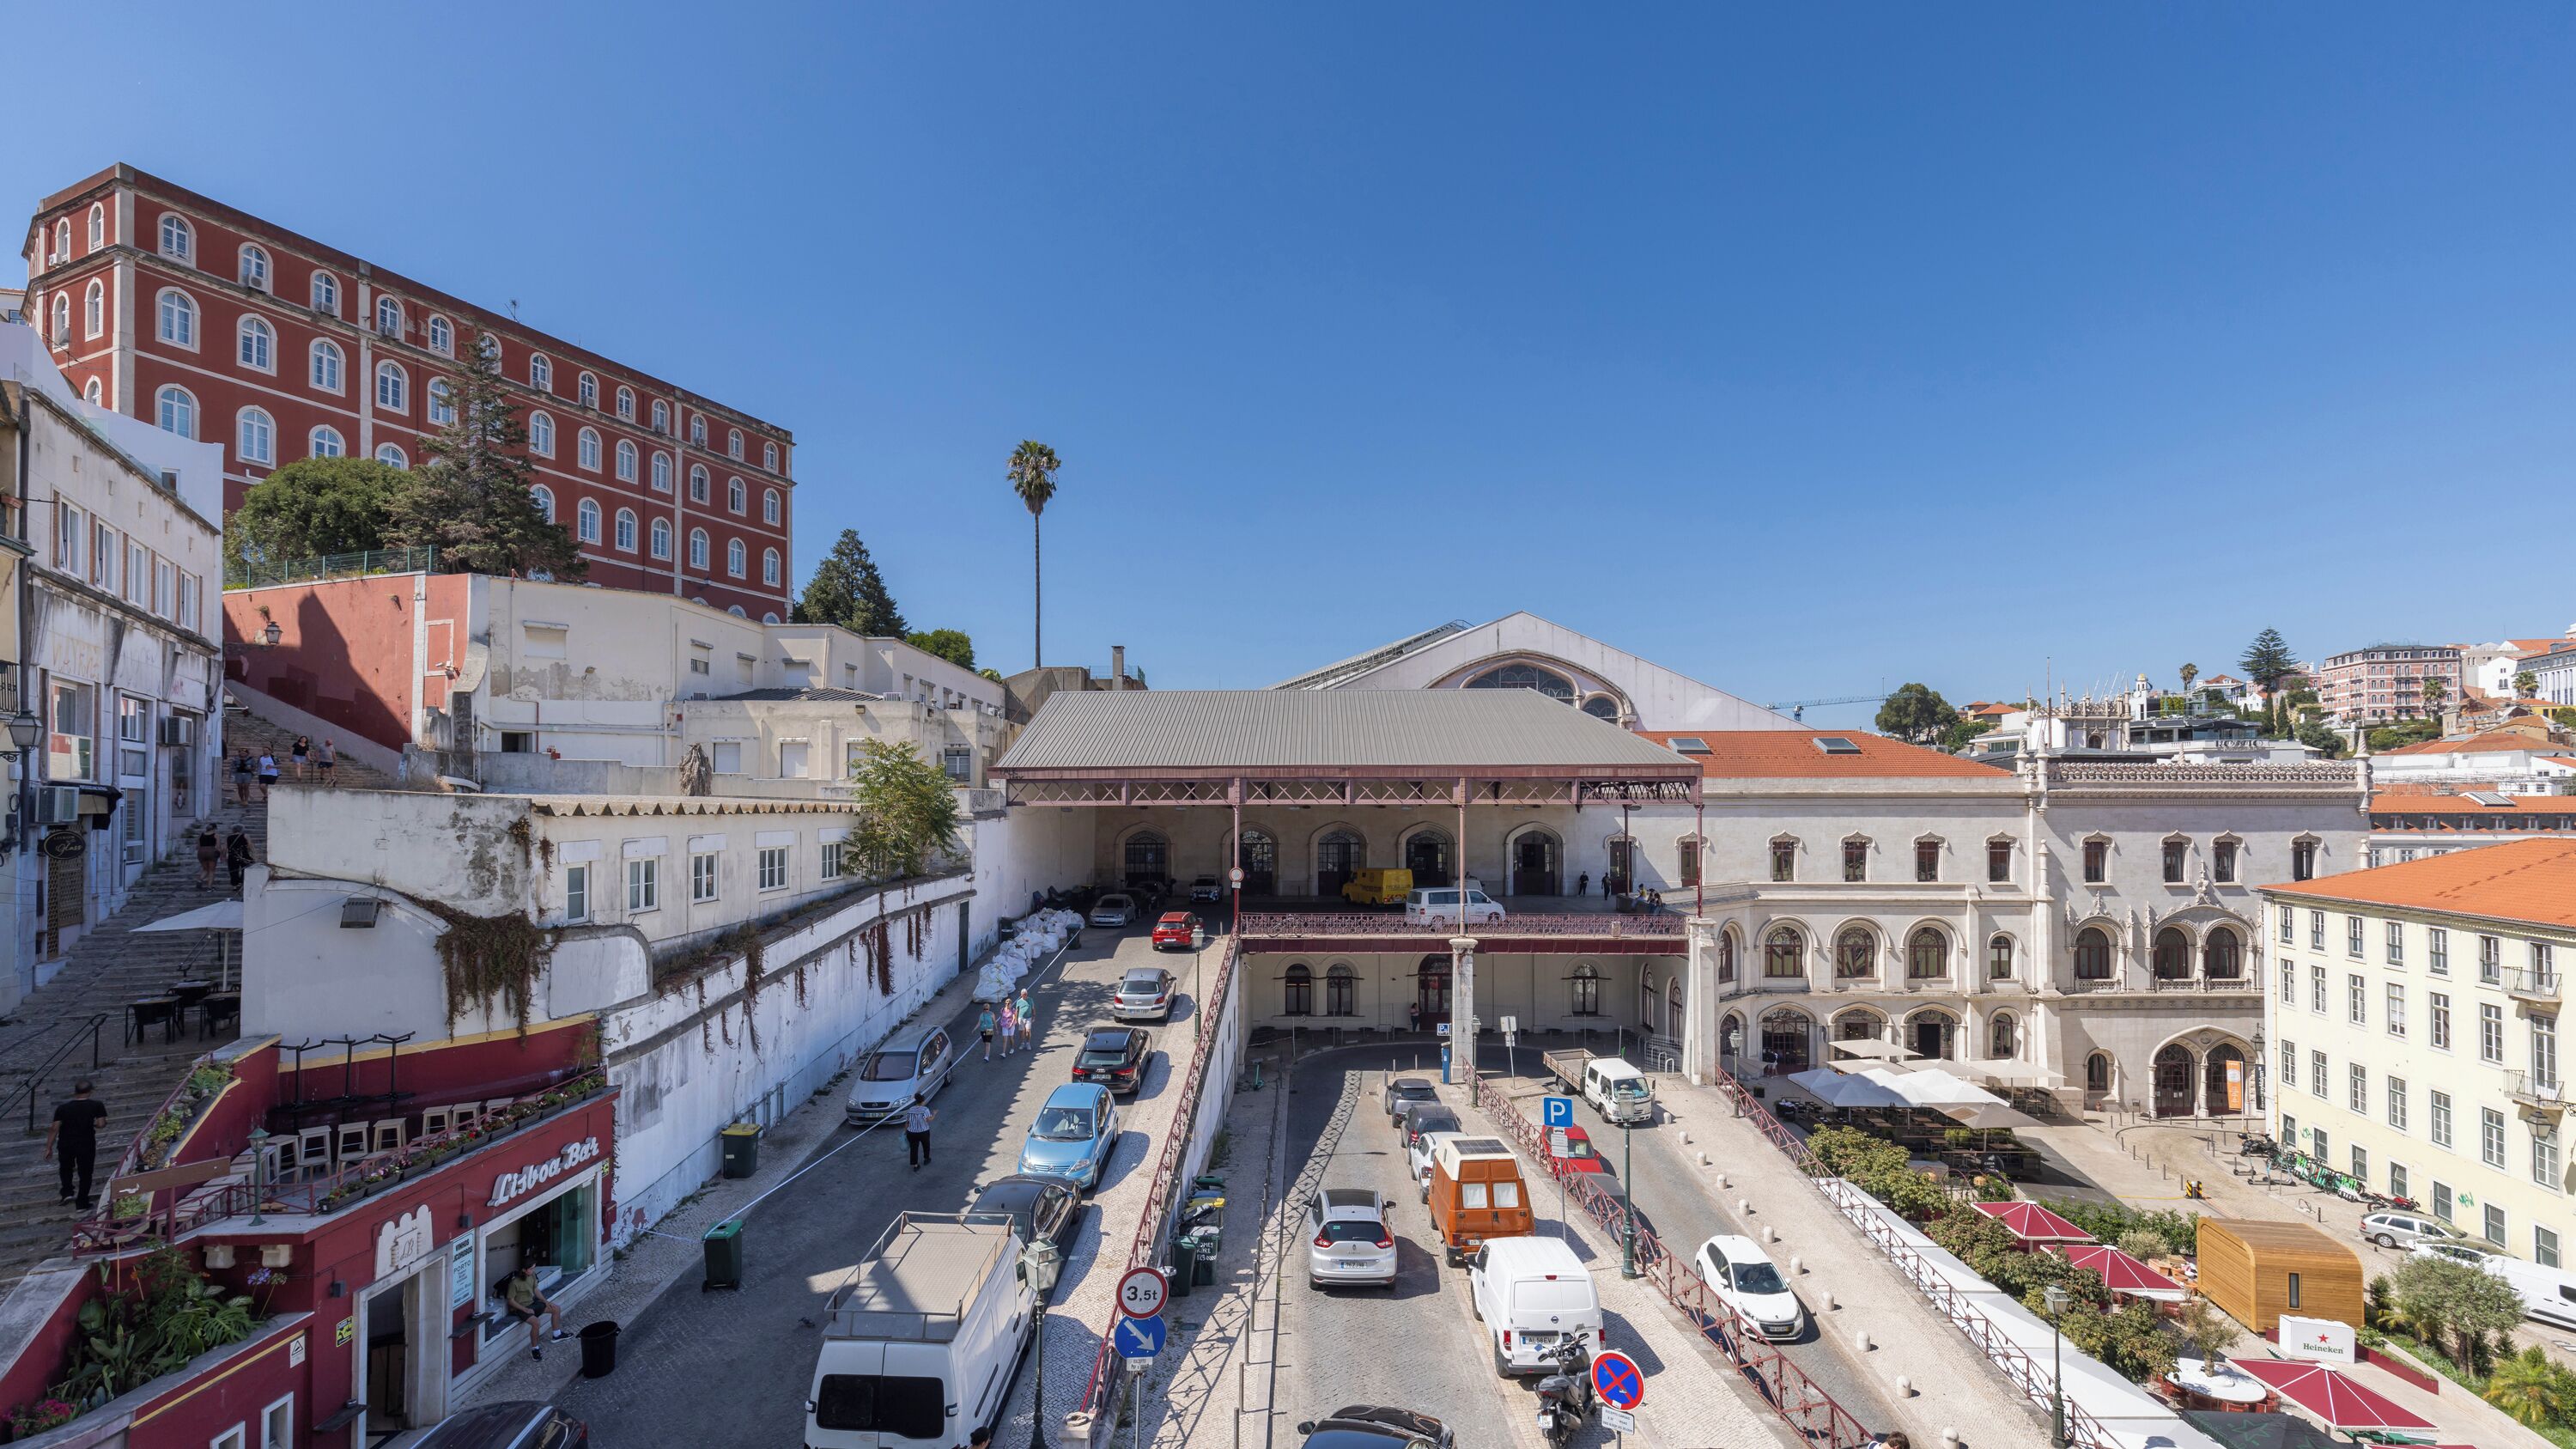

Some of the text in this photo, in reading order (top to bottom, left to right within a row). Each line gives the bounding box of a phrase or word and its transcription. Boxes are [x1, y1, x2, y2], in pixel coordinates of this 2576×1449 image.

[1550, 1101, 1565, 1123] P
[492, 1137, 599, 1207] Lisboa Bar
[1127, 1286, 1157, 1301] 3,5t
[2303, 1343, 2343, 1354] Heineken
